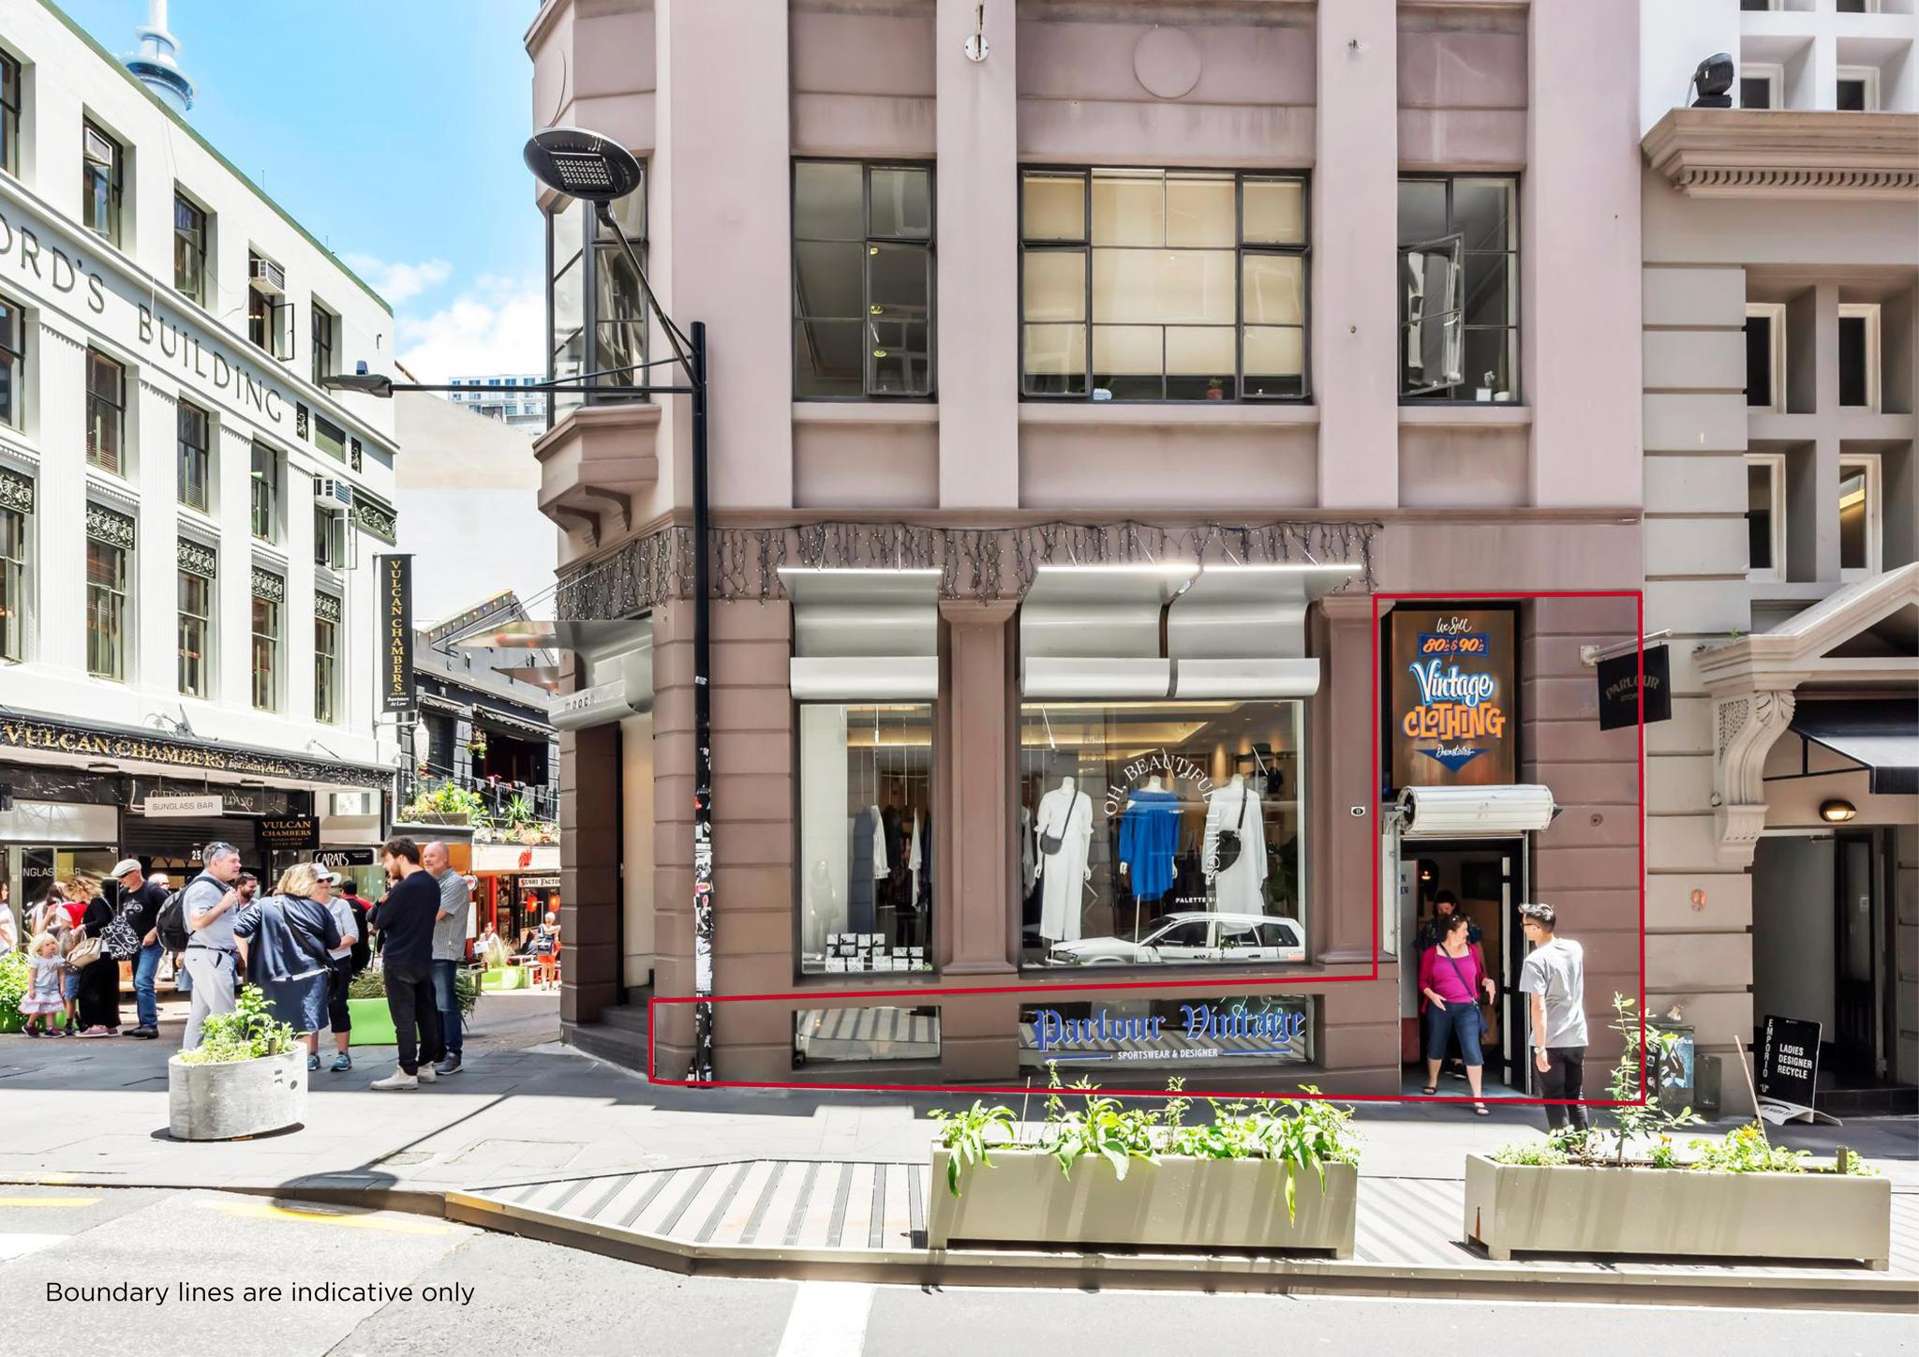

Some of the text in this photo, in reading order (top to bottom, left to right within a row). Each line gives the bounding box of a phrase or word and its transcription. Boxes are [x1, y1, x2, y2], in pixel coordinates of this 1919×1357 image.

[139, 303, 282, 423] BUILDING
[390, 560, 403, 615] VULCAN
[391, 619, 404, 692] CHAMBERS
[1410, 659, 1493, 708] Vintage
[1404, 703, 1506, 741] CLOTHING
[3, 724, 111, 754] VULCAN
[114, 740, 226, 769] CHAMBERS
[1104, 785, 1127, 816] OH,
[1123, 754, 1217, 805] BEAUTIFUL
[152, 801, 214, 811] SUNGLASS BAR
[262, 820, 312, 829] VULCAN
[22, 867, 55, 877] NGLAS
[315, 852, 349, 867] CARATS
[1023, 1003, 1306, 1053] Parlour Vintage
[1117, 1048, 1218, 1060] SPORTSWEAR & DESIGNER
[1762, 1018, 1774, 1078] EMPORIO
[1778, 1054, 1813, 1069] DESIGNER
[1779, 1043, 1804, 1056] LADIES
[1777, 1064, 1808, 1079] RECYCLE
